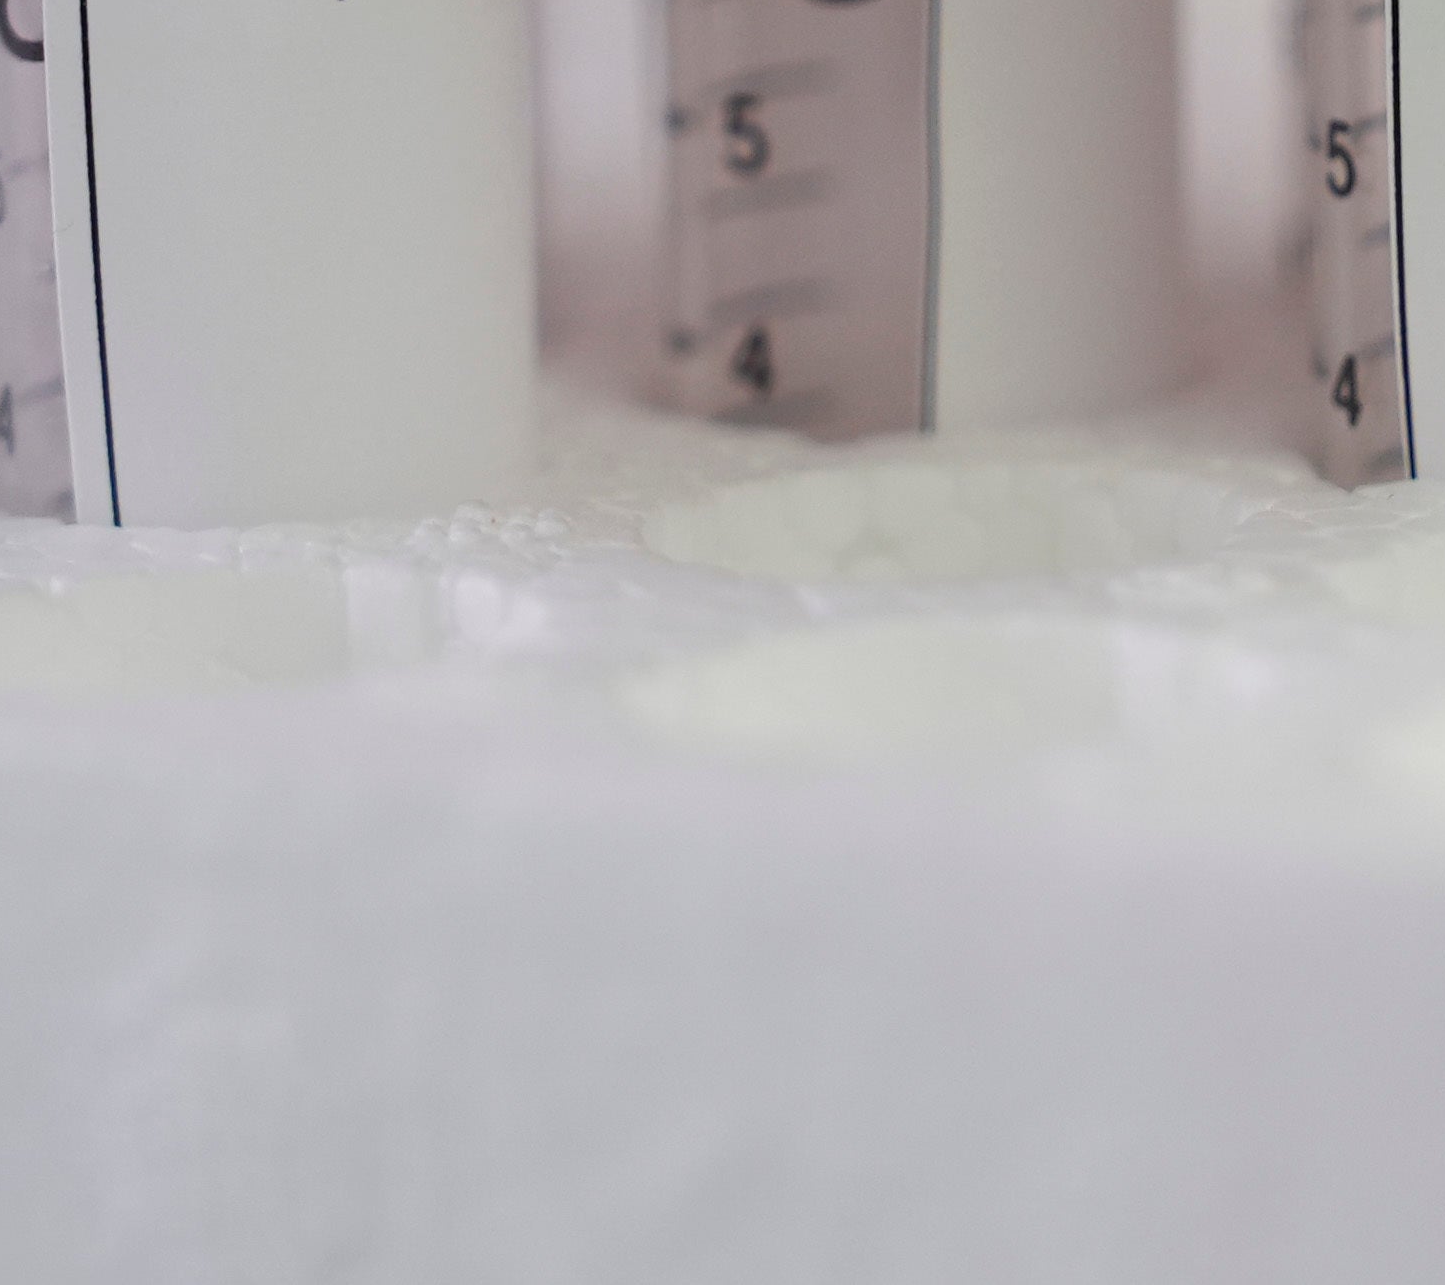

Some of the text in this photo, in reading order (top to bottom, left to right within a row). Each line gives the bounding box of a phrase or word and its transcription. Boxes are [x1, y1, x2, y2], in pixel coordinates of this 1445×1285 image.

[723, 92, 768, 178] 5
[1325, 121, 1355, 198] 5
[732, 325, 773, 401] 4
[1333, 355, 1362, 427] 4
